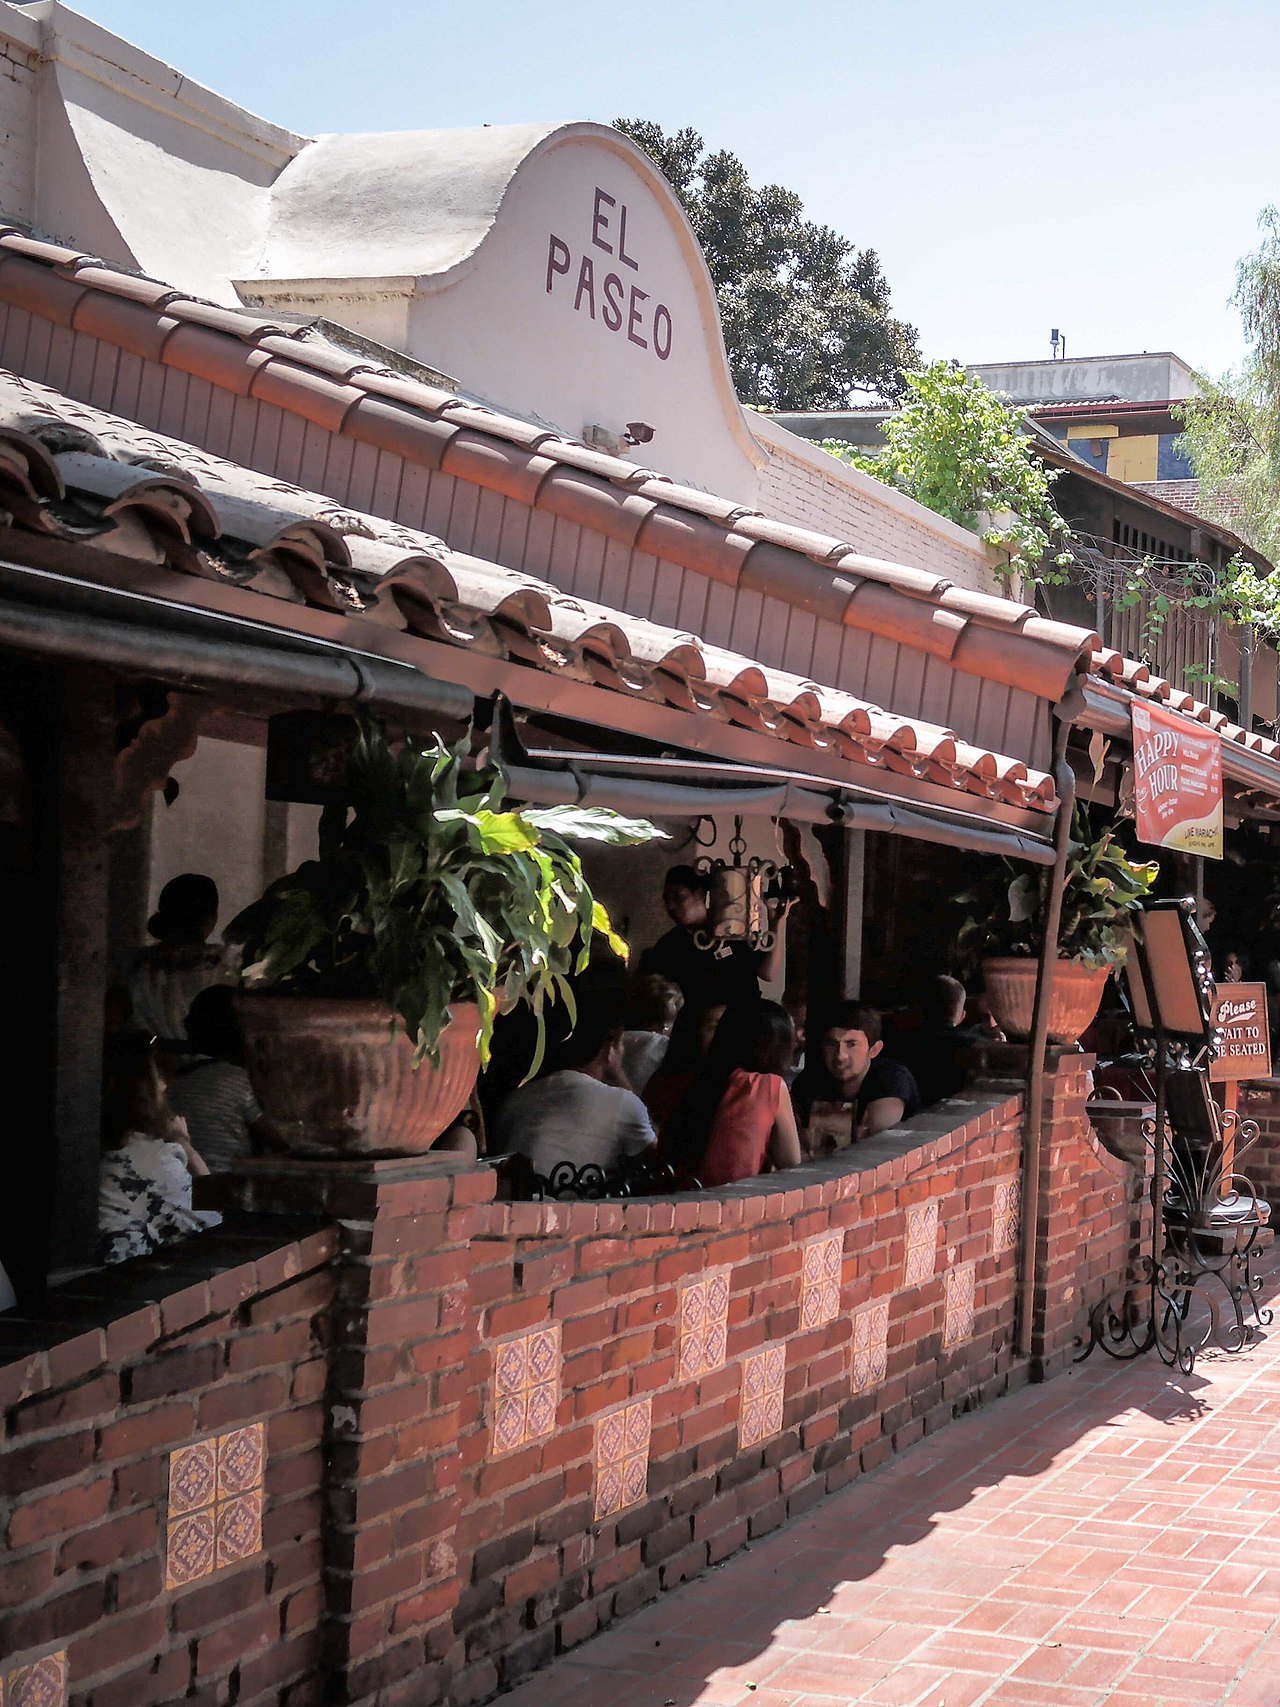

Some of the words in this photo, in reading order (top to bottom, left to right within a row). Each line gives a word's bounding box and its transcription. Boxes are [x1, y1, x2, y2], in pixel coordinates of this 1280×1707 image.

[592, 187, 639, 271] EL
[546, 233, 672, 361] PASEO
[1134, 731, 1179, 778] HAPPY
[1148, 765, 1178, 800] HOUR
[1218, 1000, 1256, 1022] Please
[1229, 1043, 1266, 1056] SEATED
[1245, 1026, 1259, 1038] TO
